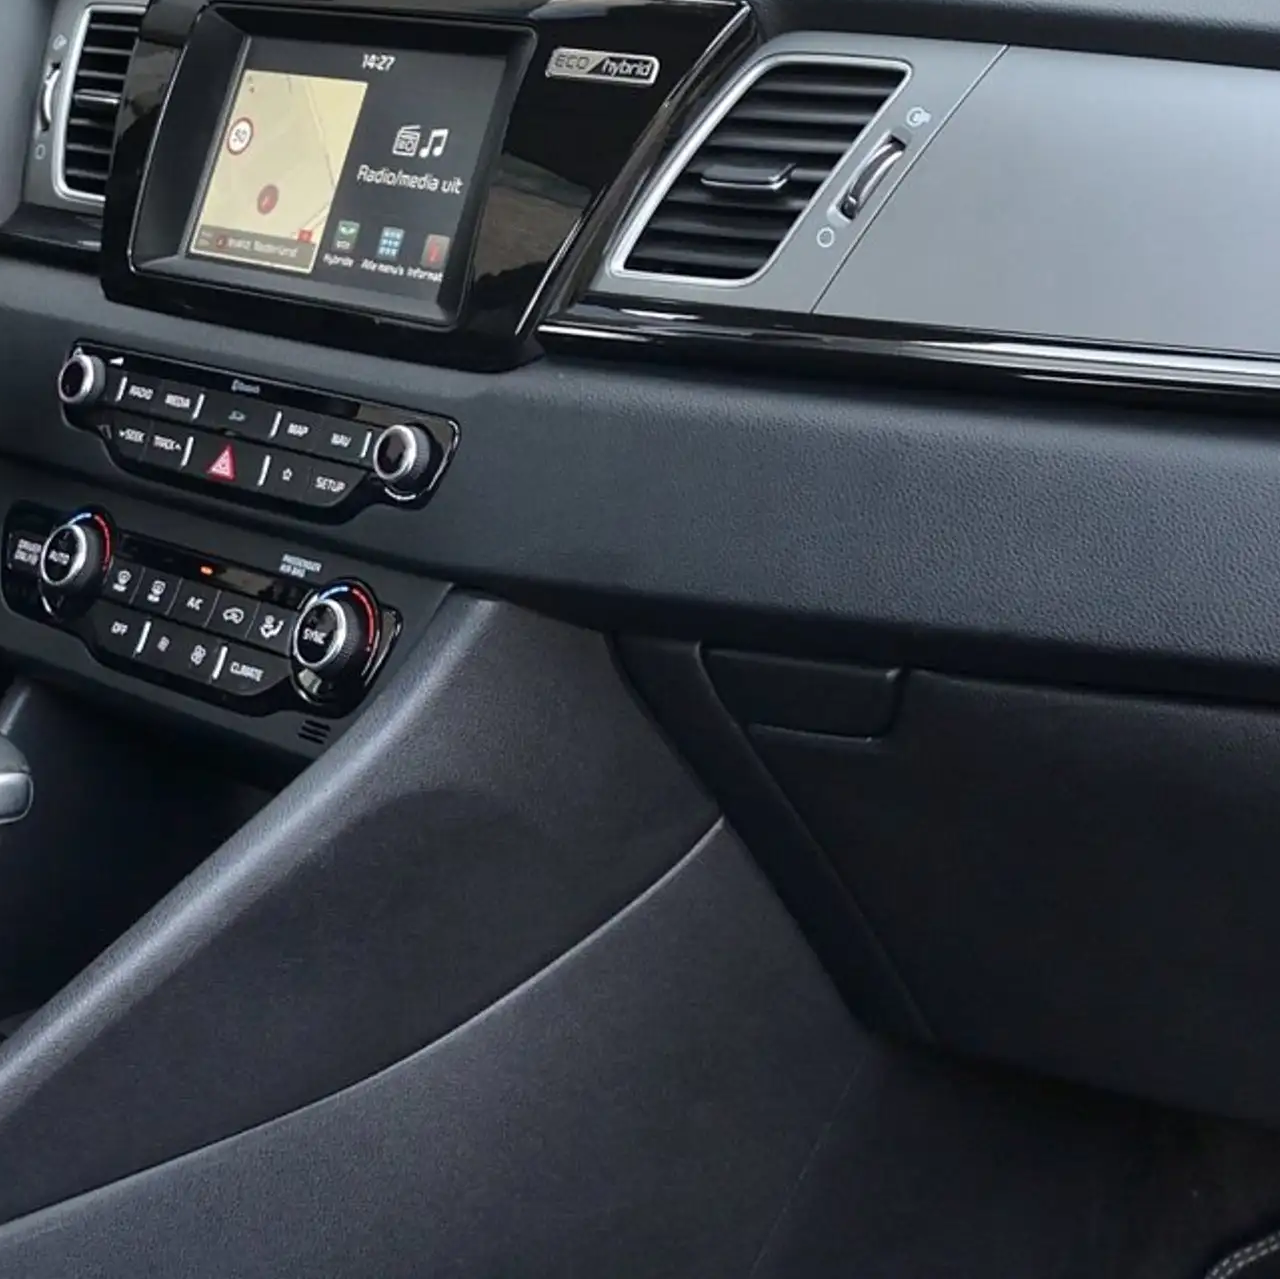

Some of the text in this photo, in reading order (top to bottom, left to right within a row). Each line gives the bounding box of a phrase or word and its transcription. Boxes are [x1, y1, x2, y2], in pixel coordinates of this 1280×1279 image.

[554, 55, 652, 77] ECO hybrid
[357, 164, 464, 195] Radio/media uit
[315, 476, 346, 493] SETUP
